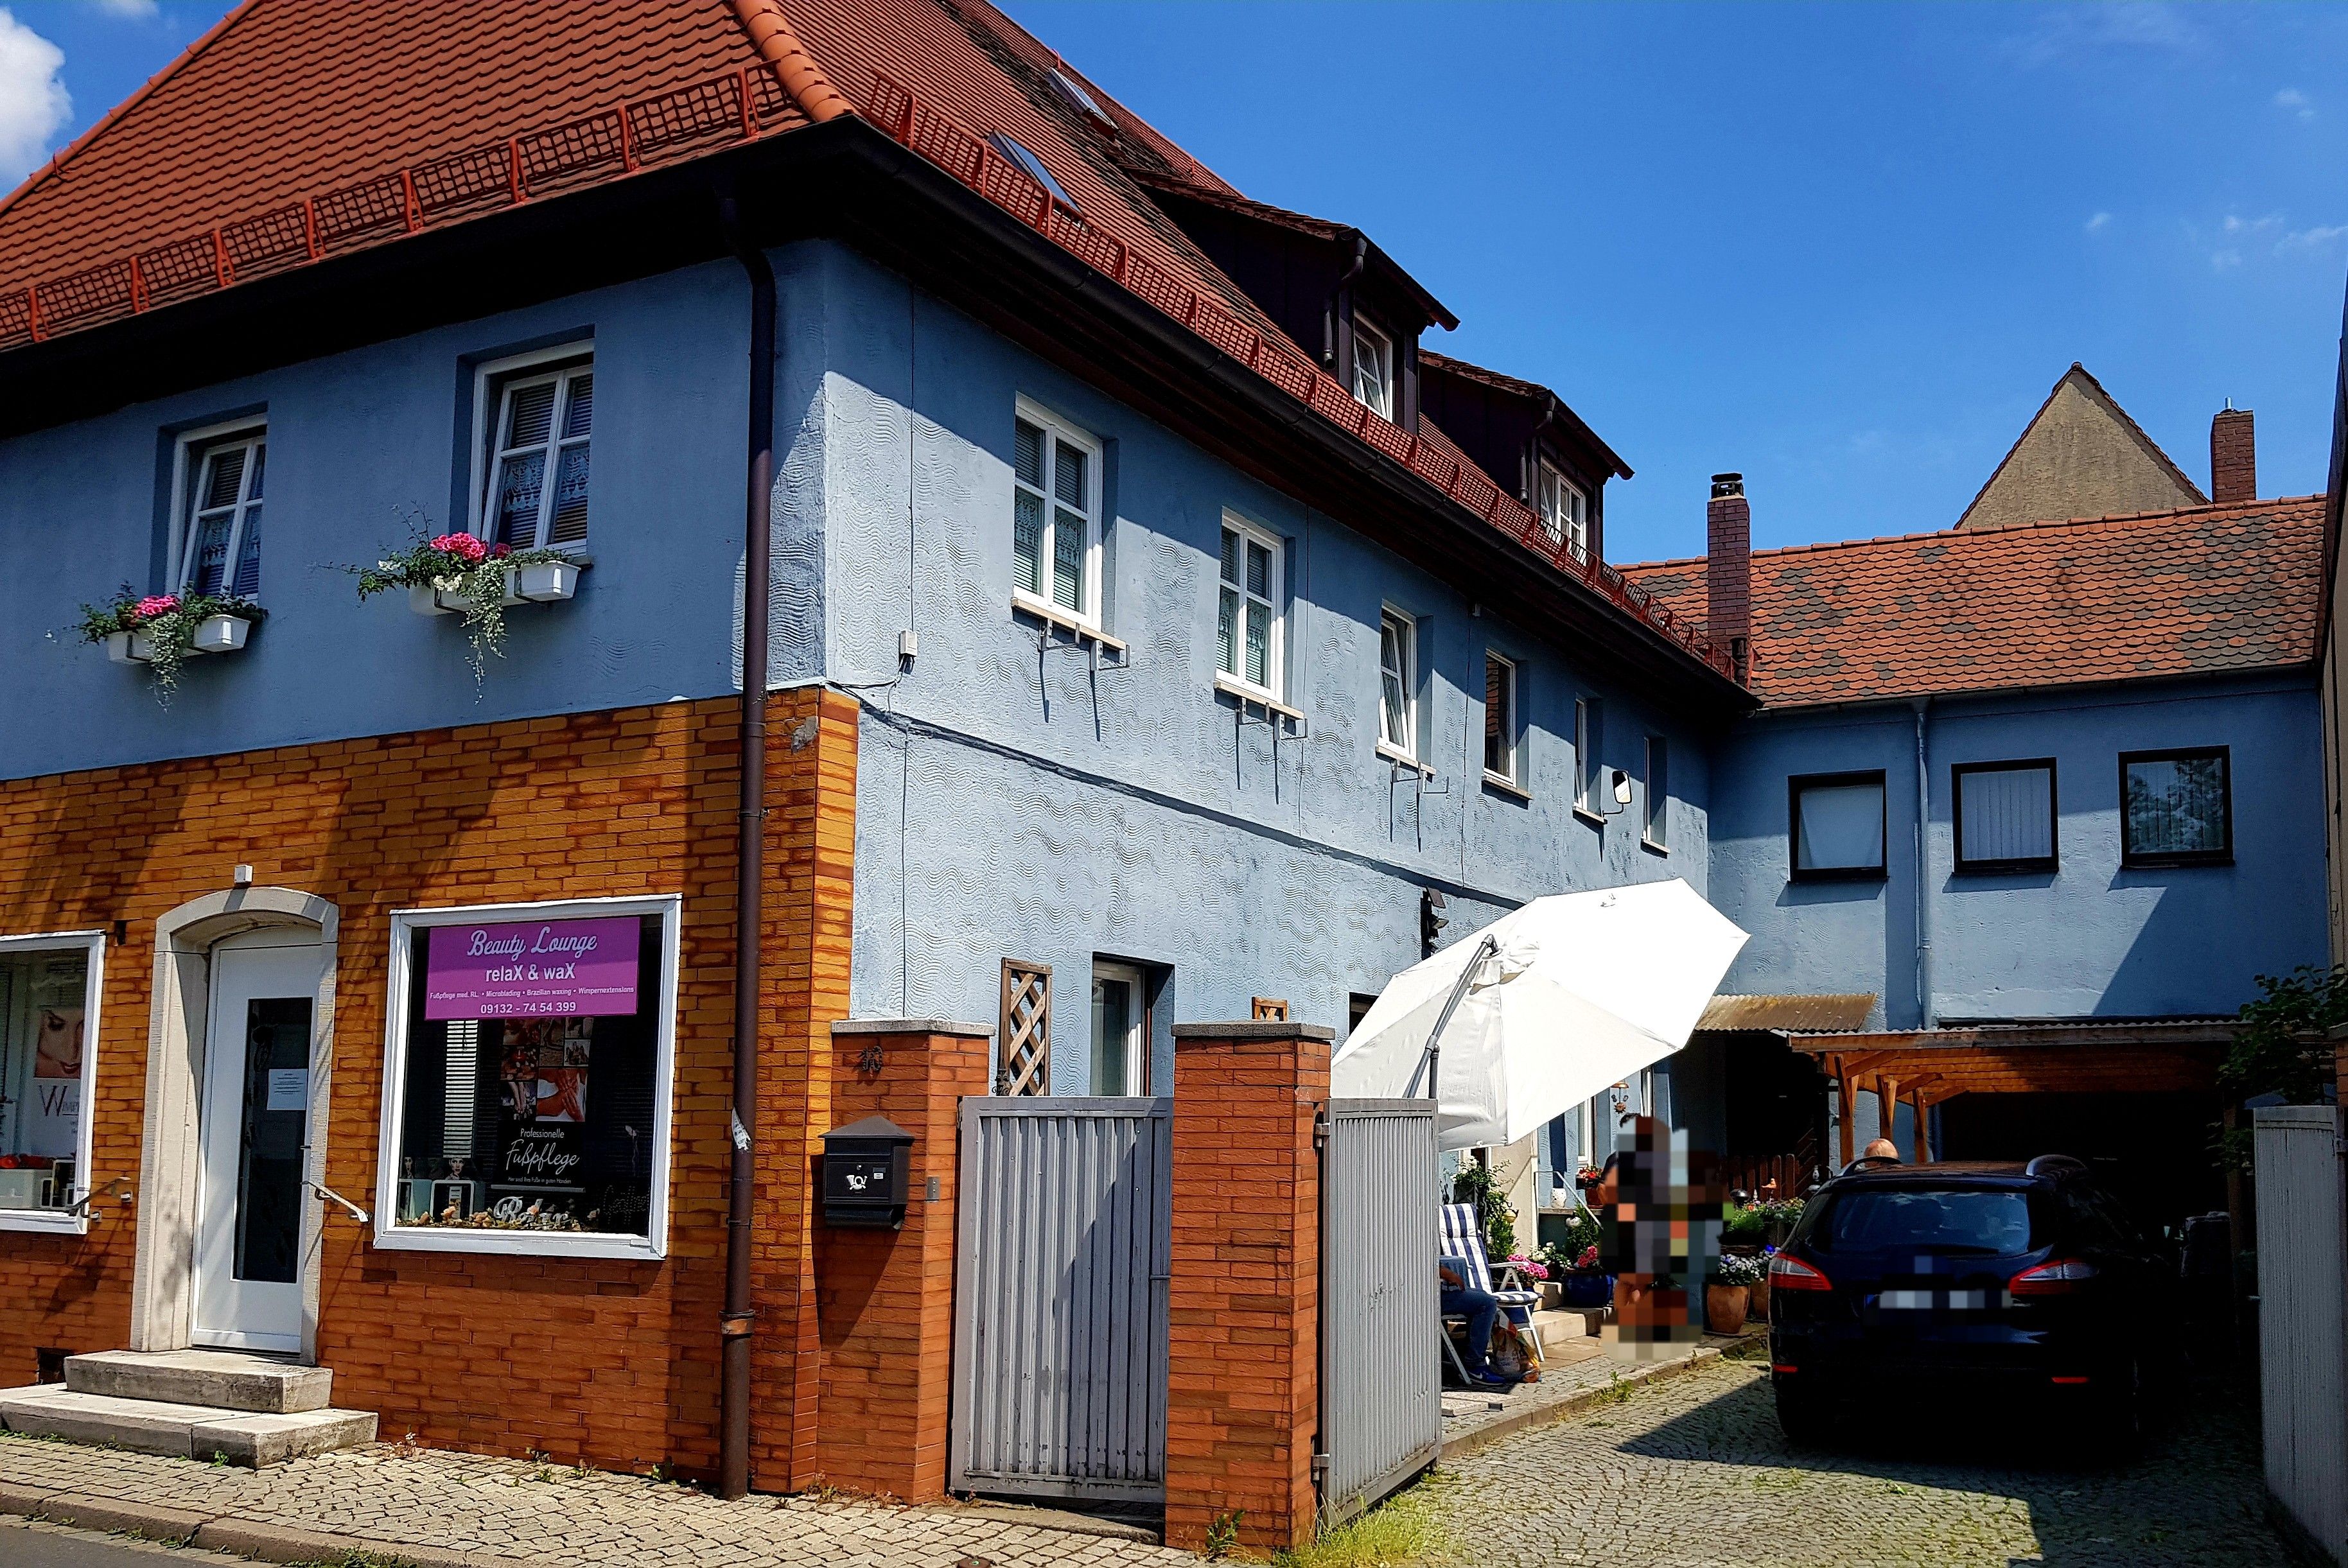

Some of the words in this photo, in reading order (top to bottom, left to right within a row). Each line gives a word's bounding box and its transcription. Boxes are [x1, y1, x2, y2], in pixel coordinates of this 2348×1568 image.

[467, 930, 526, 961] Beauty
[530, 926, 597, 959] Lounge
[486, 964, 523, 982] relaX
[527, 964, 539, 980] &
[543, 963, 575, 980] waX
[578, 986, 635, 995] Wimpernextensions
[480, 1004, 513, 1014] 09132
[523, 1002, 536, 1013] 74
[539, 1002, 552, 1012] 54
[556, 1002, 576, 1012] 399
[520, 1127, 565, 1138] Professionelle
[505, 1138, 580, 1175] Fußpflege
